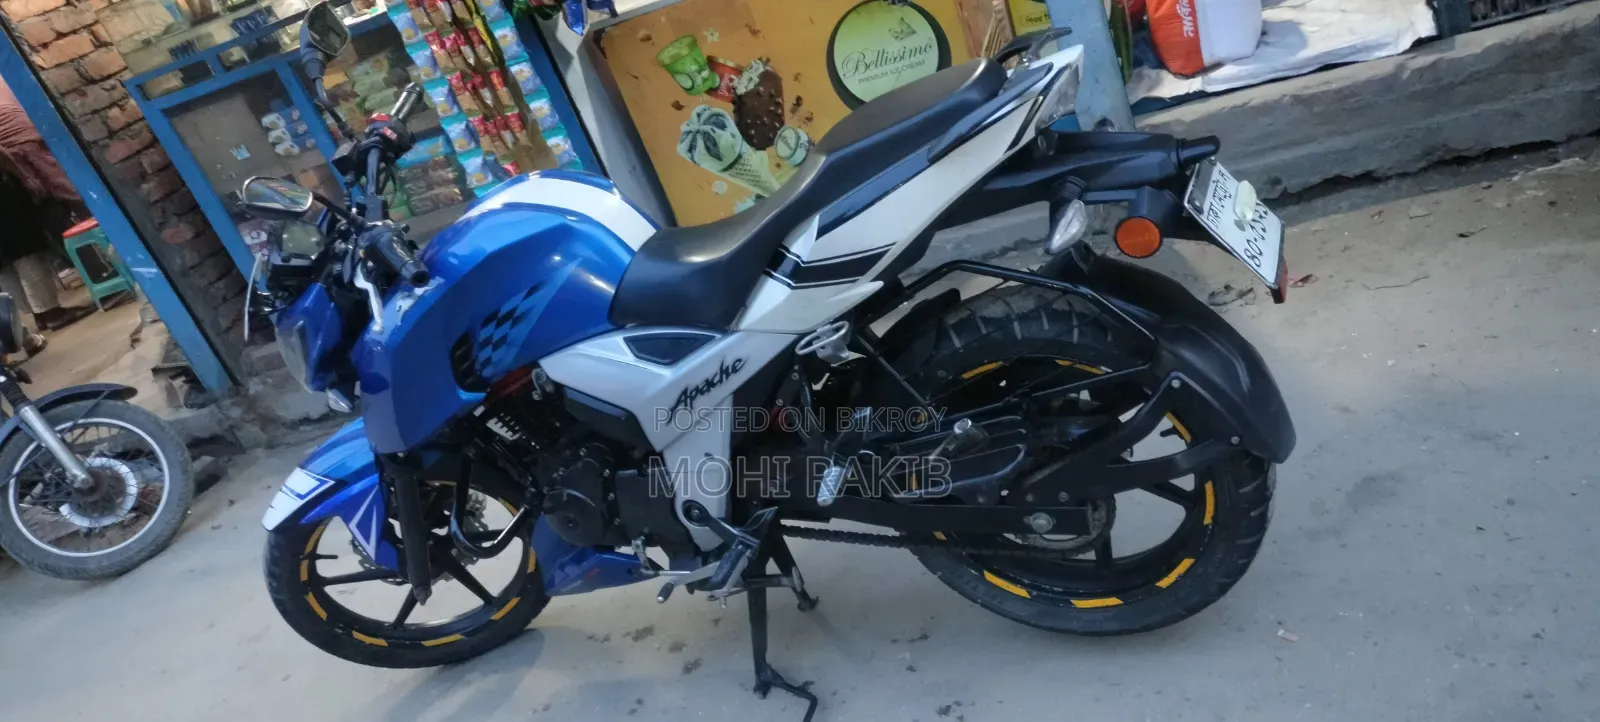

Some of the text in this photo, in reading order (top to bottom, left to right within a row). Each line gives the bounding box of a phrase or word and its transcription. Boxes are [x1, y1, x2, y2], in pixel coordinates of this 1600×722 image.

[842, 42, 933, 79] Bellissimo
[858, 60, 926, 84] PREMIUM ICE CREAM
[666, 355, 747, 427] Apache
